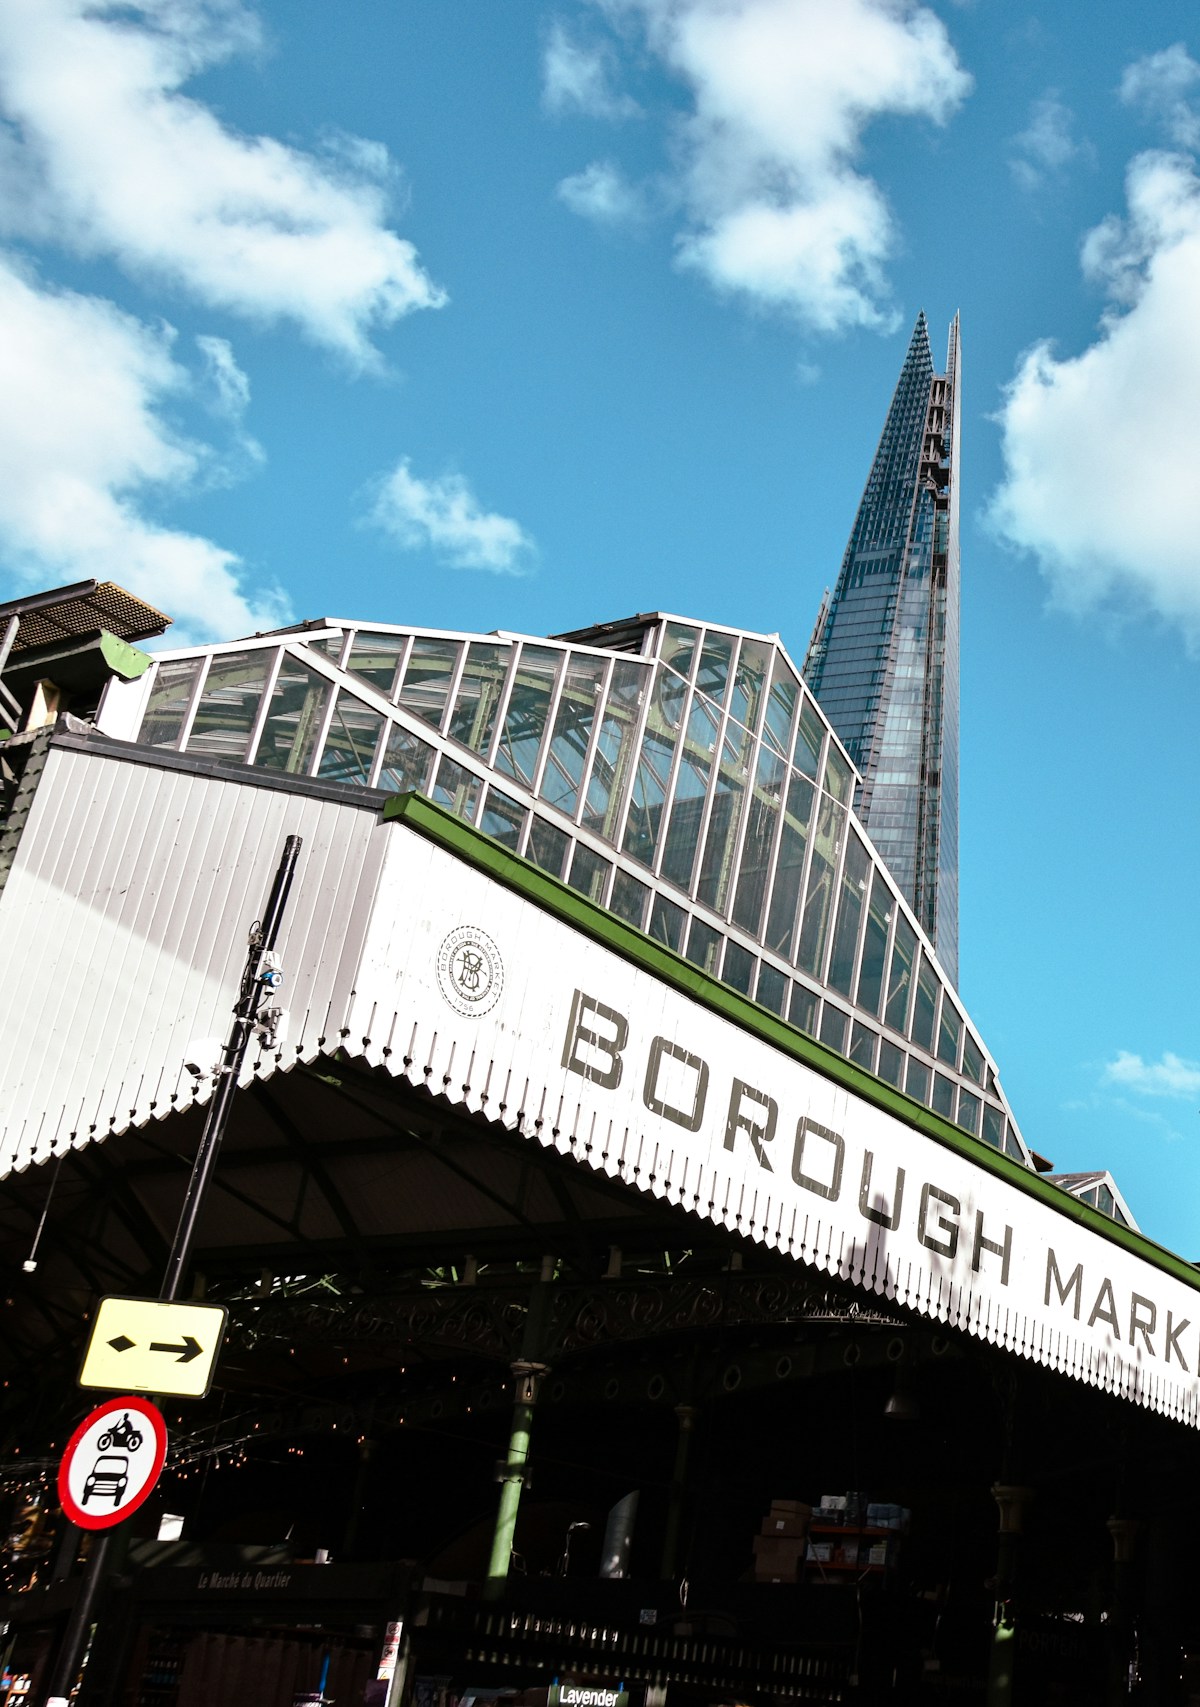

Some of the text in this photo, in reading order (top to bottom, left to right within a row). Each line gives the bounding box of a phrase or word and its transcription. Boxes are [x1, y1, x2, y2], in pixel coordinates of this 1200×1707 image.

[441, 931, 481, 972] BOROUGH
[485, 942, 500, 999] MARKET
[454, 998, 474, 1011] 1756
[562, 988, 1012, 1287] BOROUGH
[197, 1571, 209, 1589] Le
[240, 1571, 253, 1588] du
[254, 1571, 291, 1590] Quartier
[560, 1685, 619, 1707] Lavender
